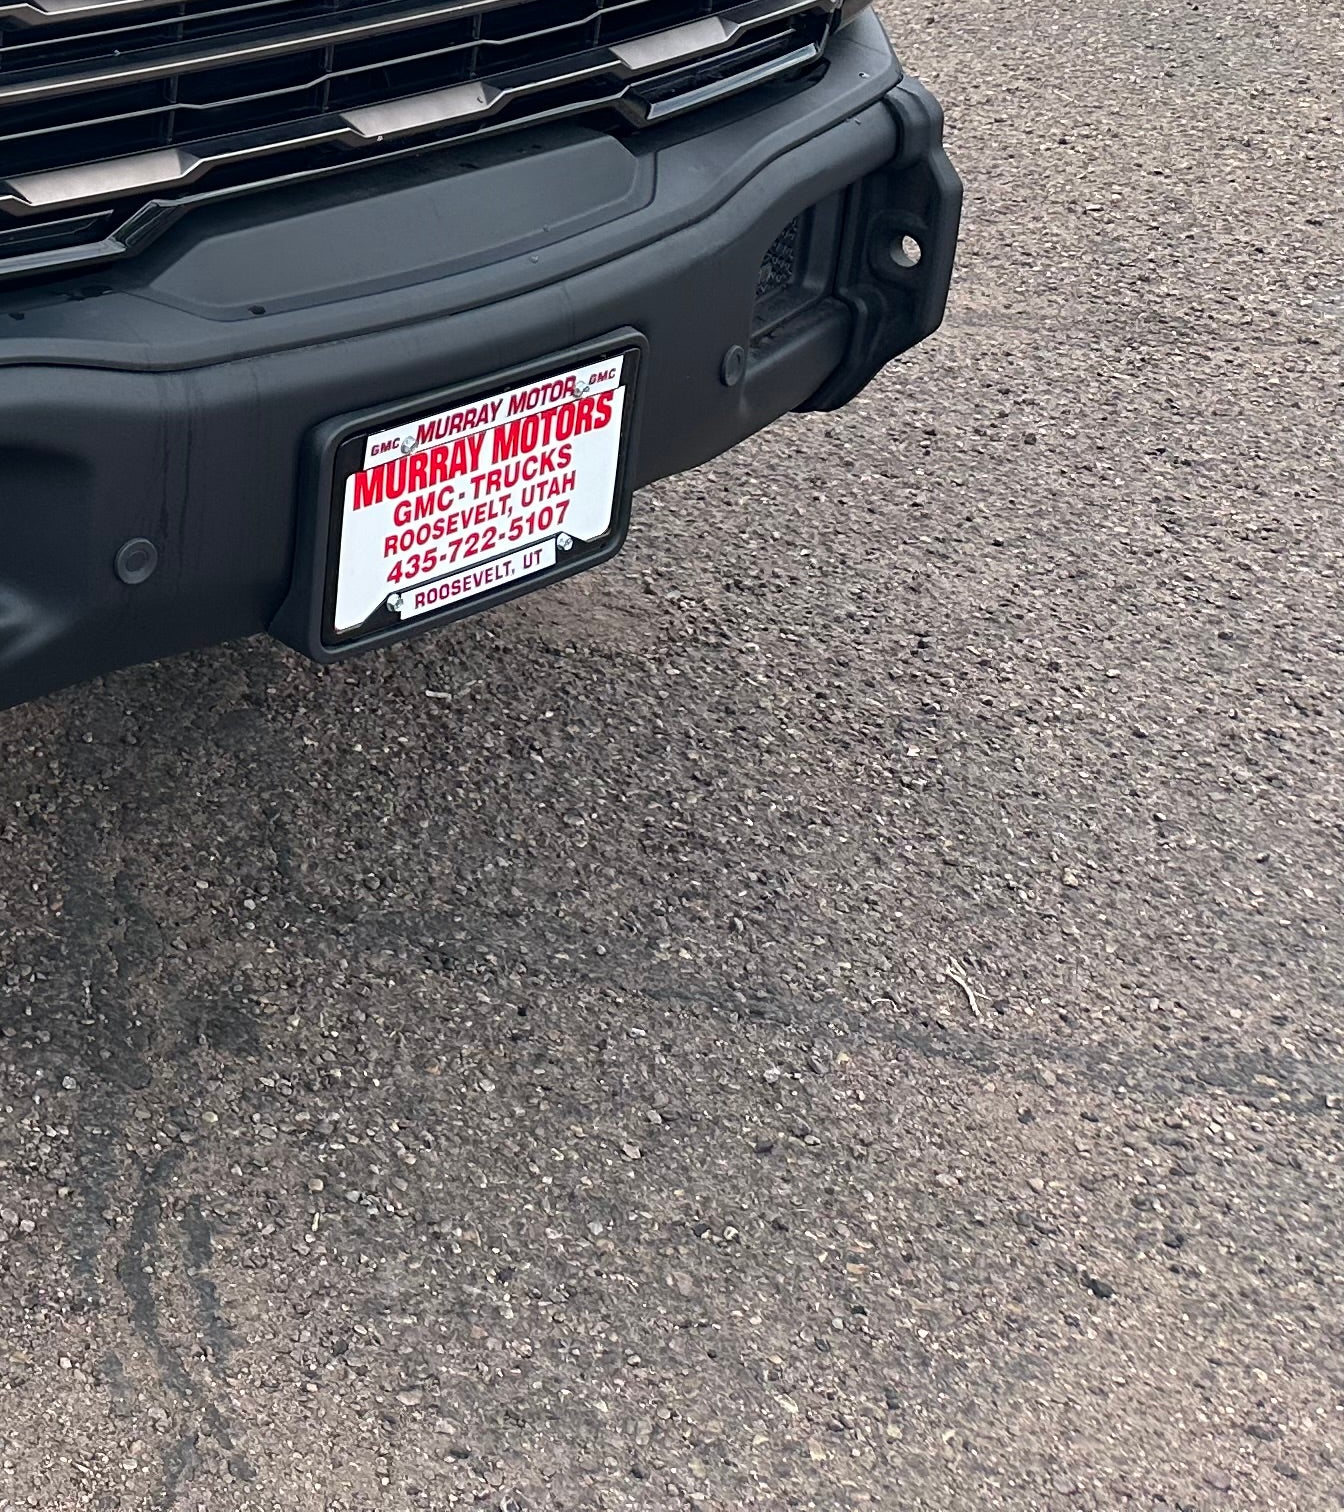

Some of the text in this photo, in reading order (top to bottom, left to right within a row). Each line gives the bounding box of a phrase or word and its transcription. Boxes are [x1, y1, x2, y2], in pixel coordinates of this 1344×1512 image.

[352, 388, 614, 513] MURRAY MOTORS
[370, 367, 617, 457] GMC MURRAY MOTOR GMC
[383, 470, 577, 559] ROOSEVELT, UTAH
[386, 500, 571, 585] 435-722-5107
[414, 549, 544, 610] ROOSEVELT, UT
